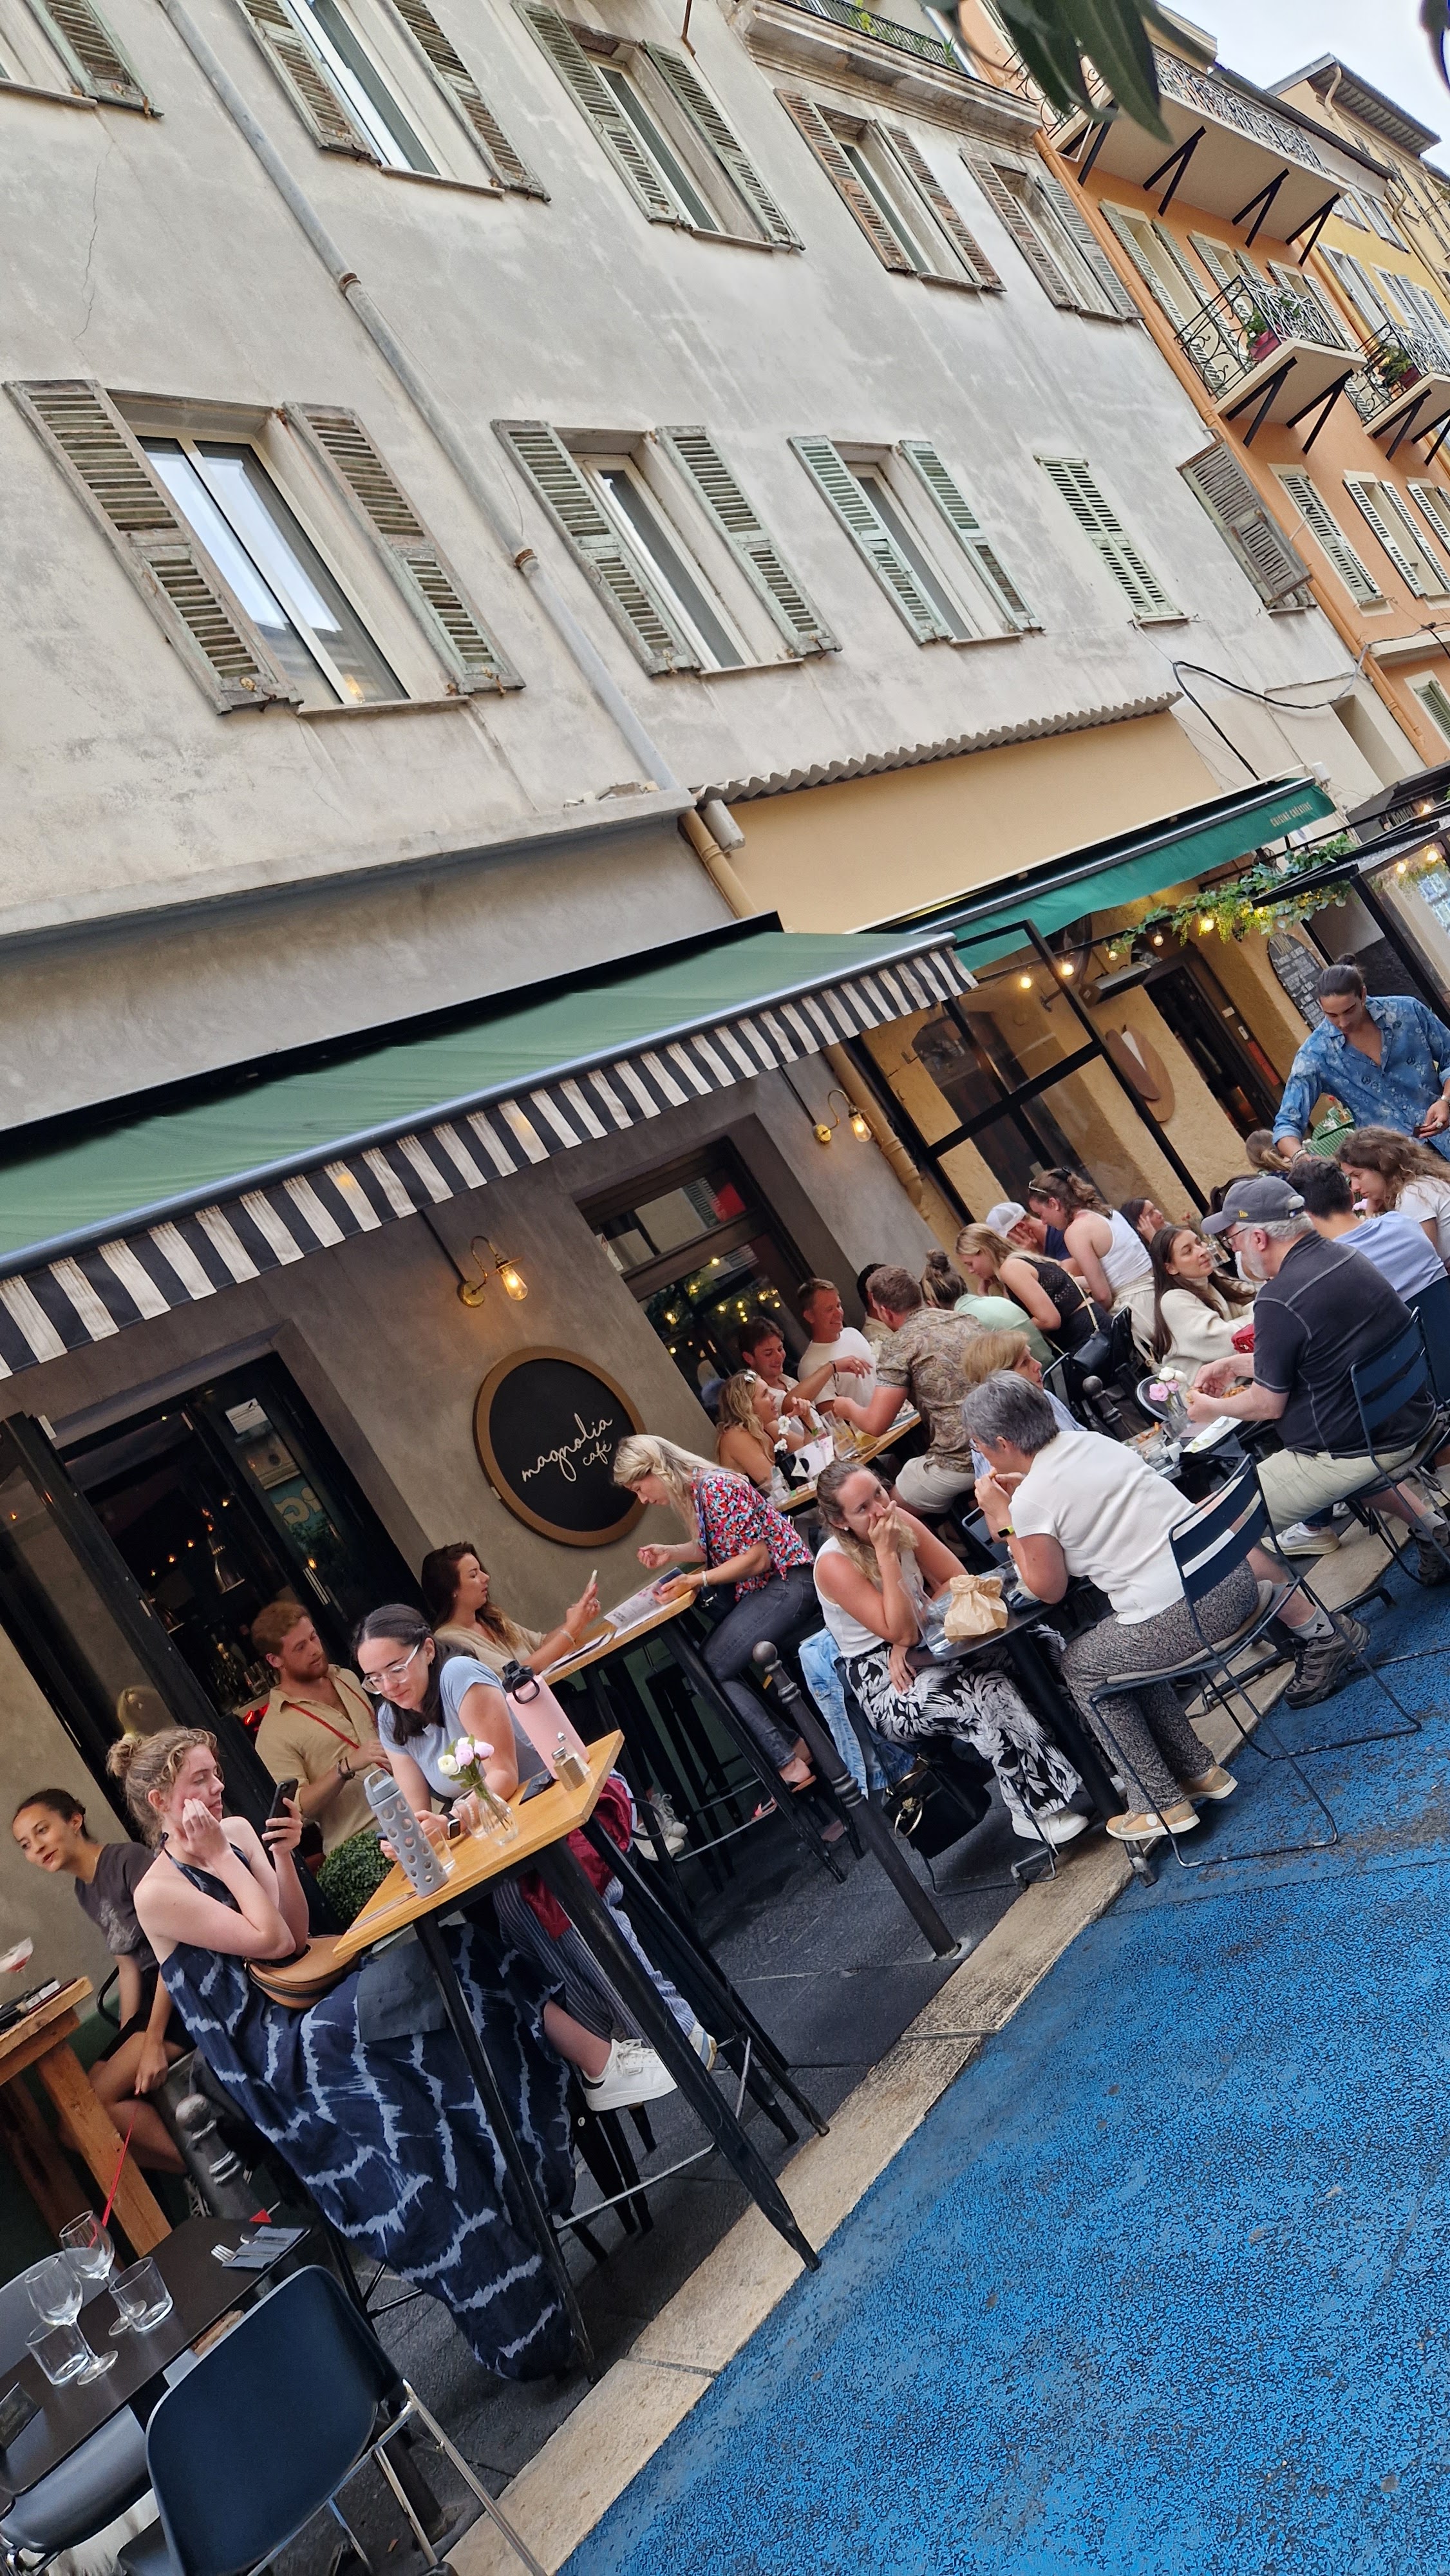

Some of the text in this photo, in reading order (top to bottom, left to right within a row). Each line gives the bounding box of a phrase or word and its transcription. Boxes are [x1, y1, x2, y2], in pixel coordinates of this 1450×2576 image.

[1270, 811, 1292, 828] CUISINE
[522, 1412, 613, 1482] magnolia
[582, 1440, 612, 1466] café
